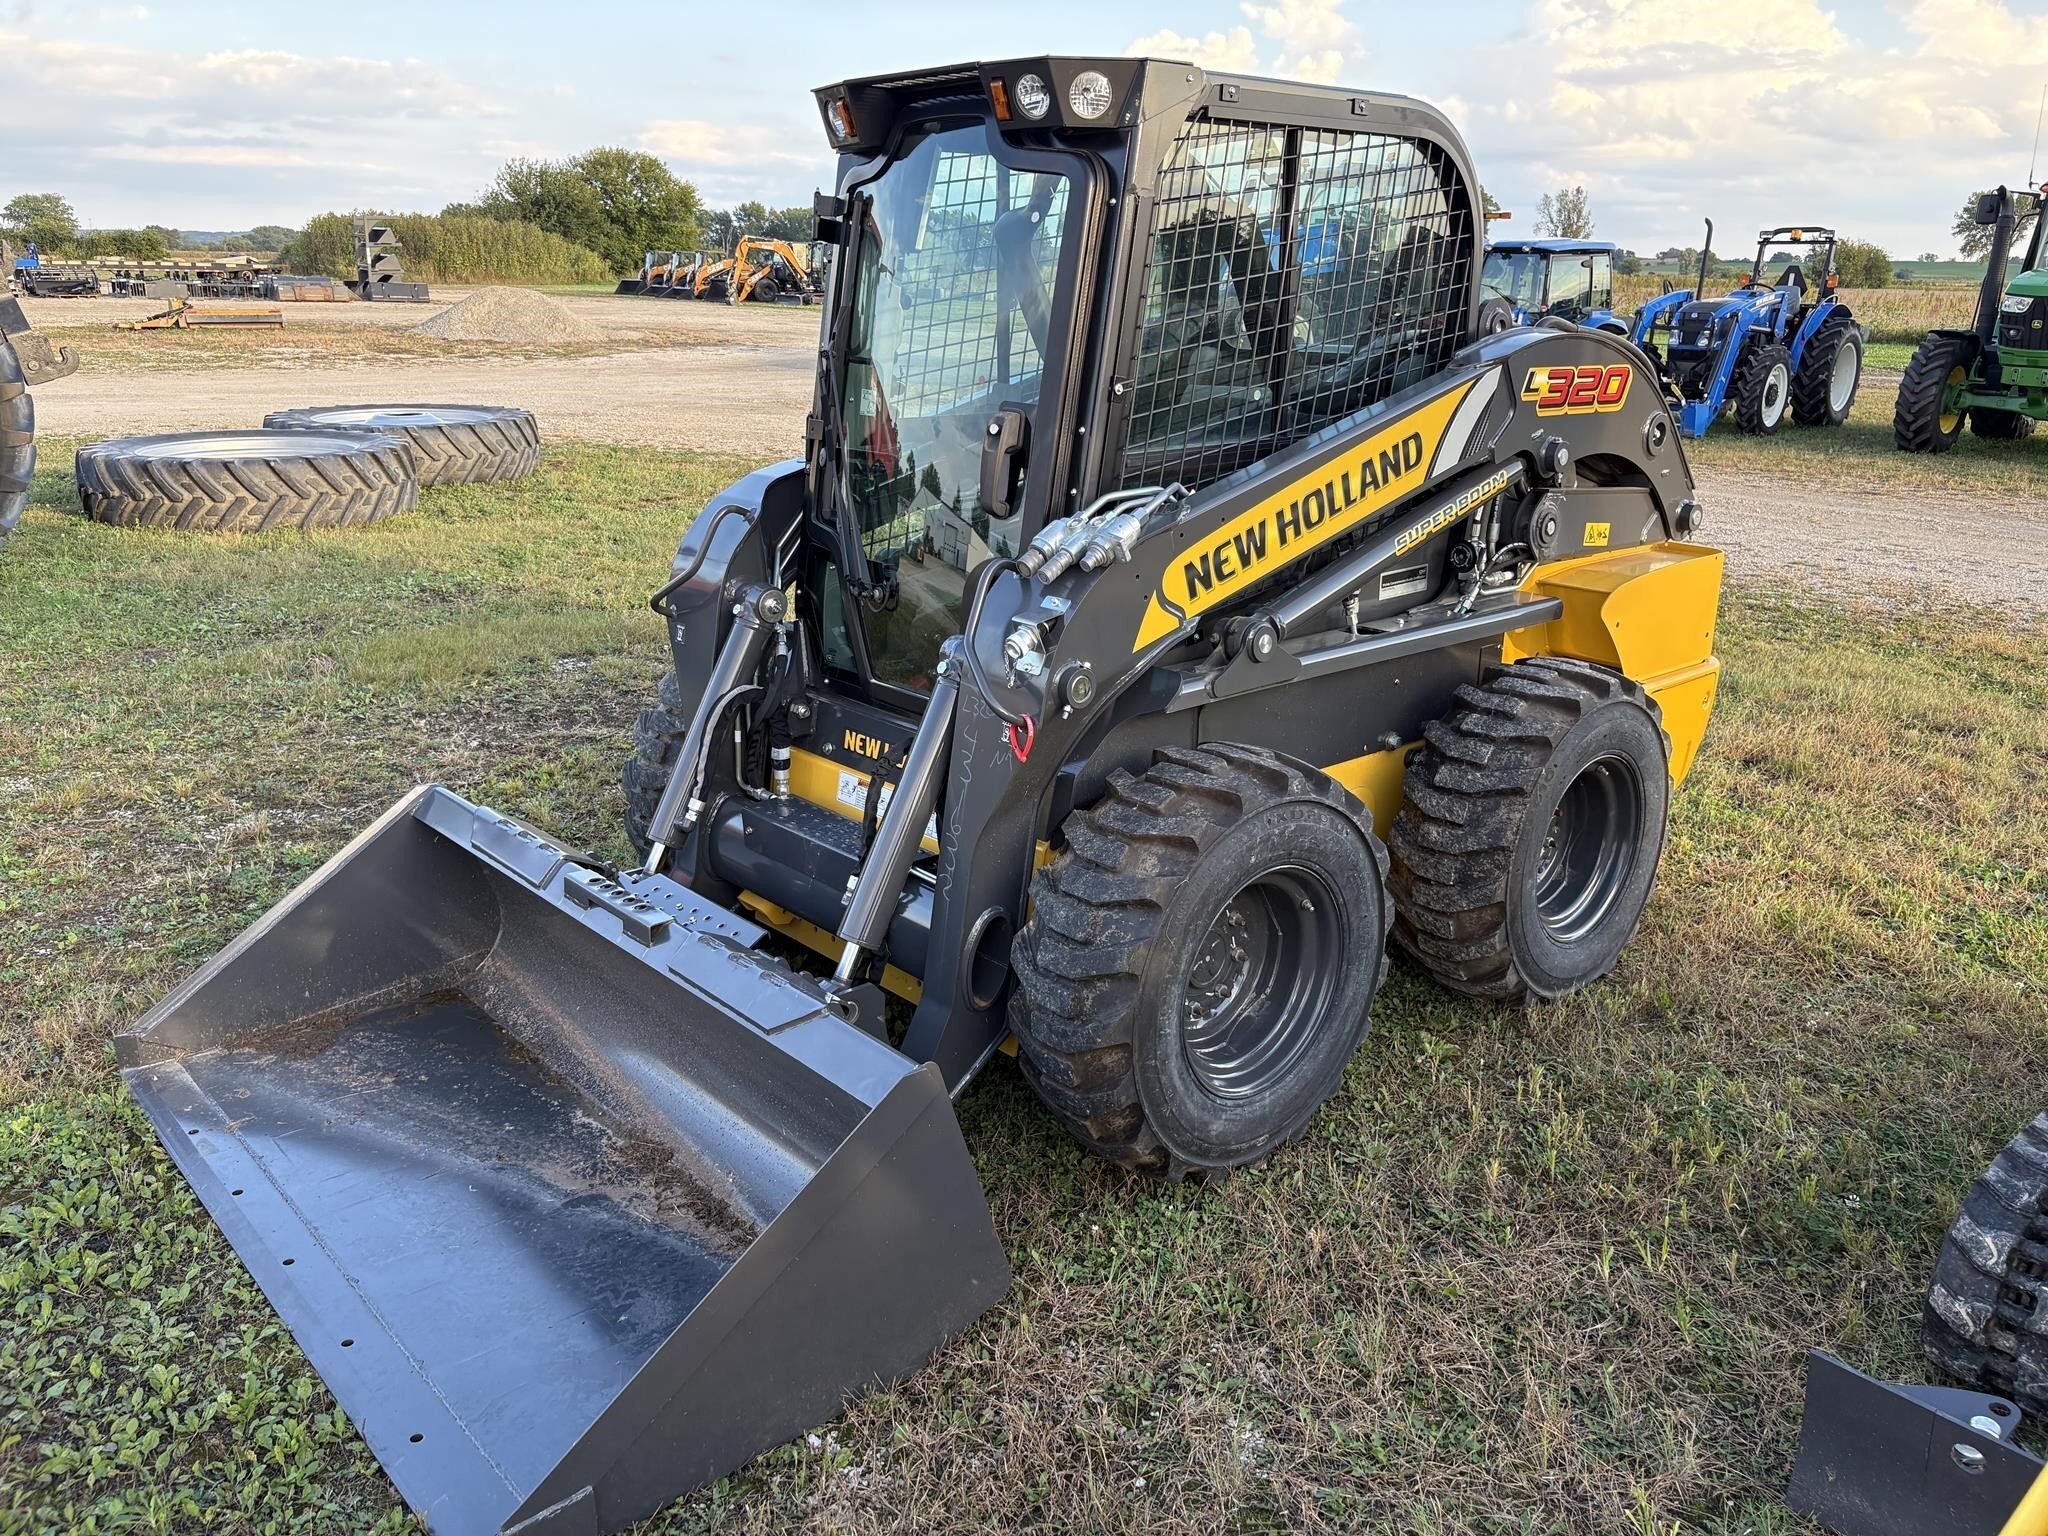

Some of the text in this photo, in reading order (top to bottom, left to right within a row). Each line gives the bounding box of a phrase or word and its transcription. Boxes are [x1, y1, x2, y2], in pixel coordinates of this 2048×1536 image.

[1521, 365, 1632, 415] L320
[1183, 431, 1424, 602] NEW HOLLAND
[1395, 470, 1508, 556] SUPER BOOM
[843, 729, 881, 760] NEW
